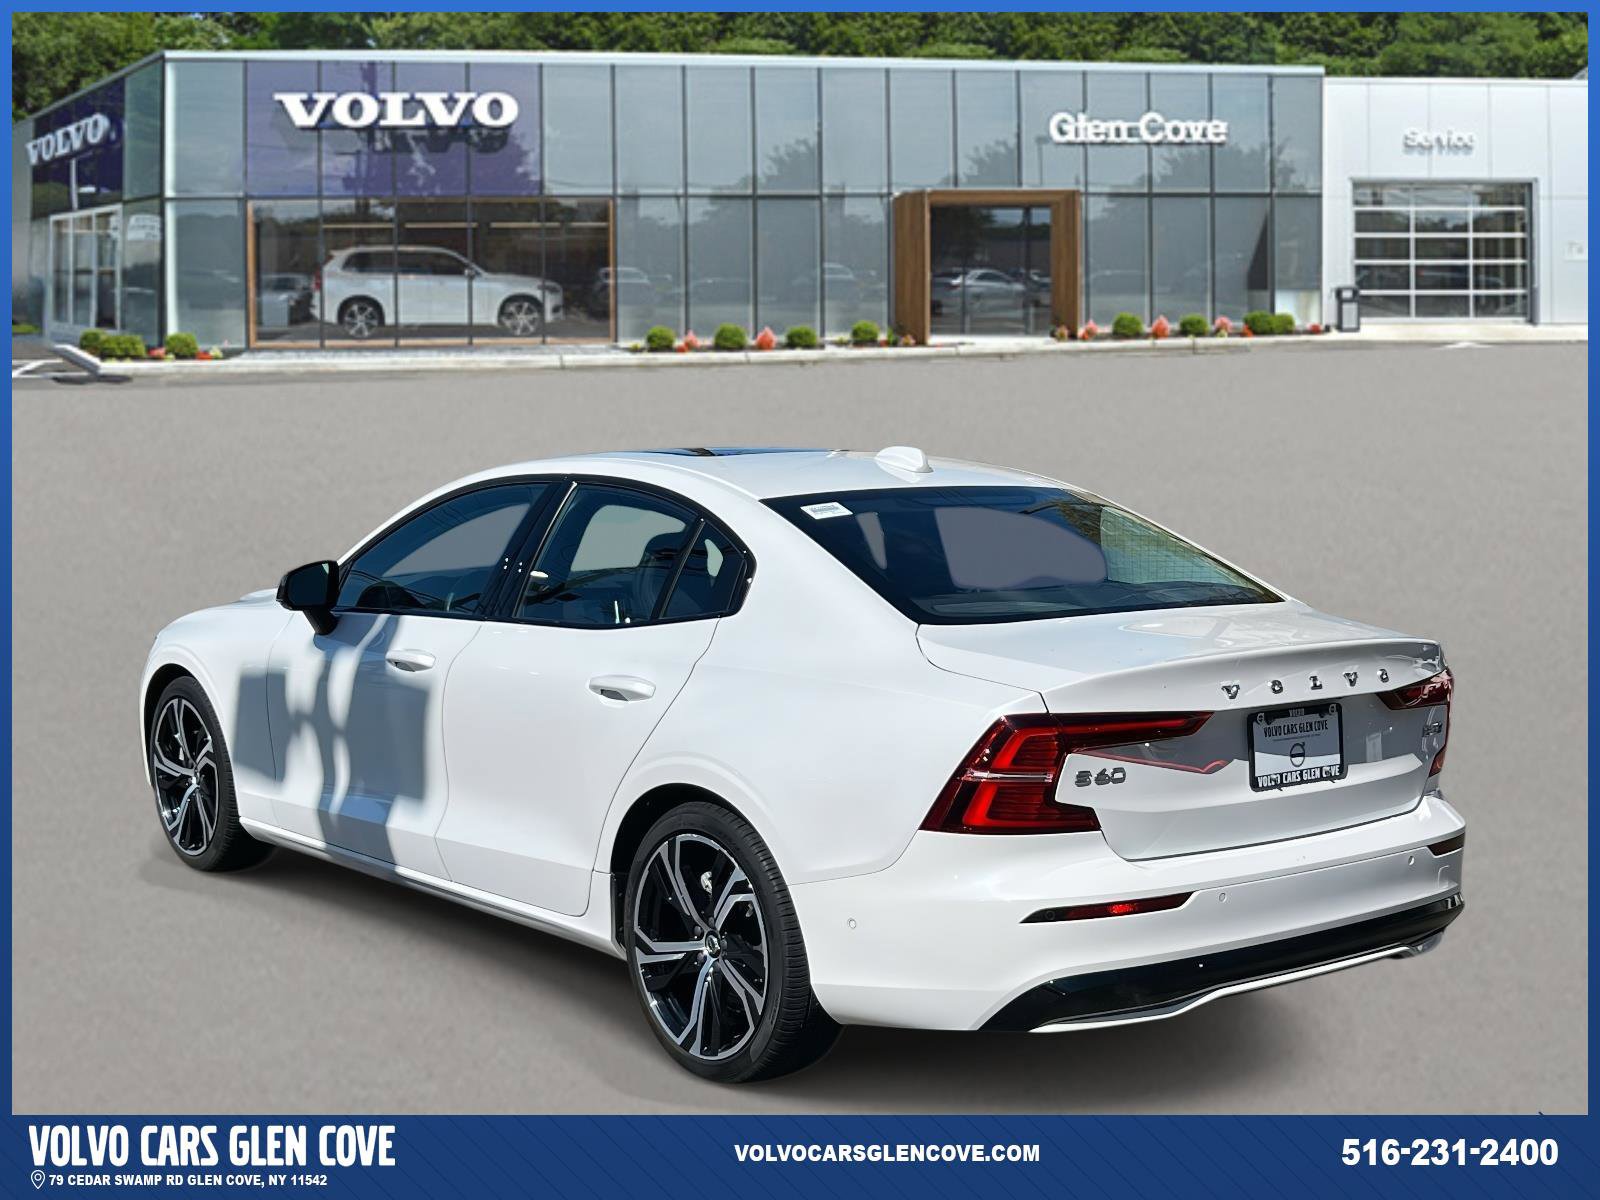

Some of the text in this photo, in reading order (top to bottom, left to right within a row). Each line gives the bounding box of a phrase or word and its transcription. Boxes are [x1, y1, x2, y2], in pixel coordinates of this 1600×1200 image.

[274, 92, 519, 128] VOLVO
[25, 112, 110, 165] VOLVO
[1049, 112, 1228, 144] Glen Cove
[1402, 127, 1475, 151] Service
[1221, 668, 1390, 700] VOLVO
[1263, 726, 1282, 738] VOLVO
[1282, 723, 1298, 736] CARS
[1298, 721, 1314, 733] GLEN
[1314, 719, 1329, 732] COVE
[1075, 766, 1126, 787] S60
[1282, 770, 1302, 784] CARS
[1302, 767, 1321, 781] GLEN
